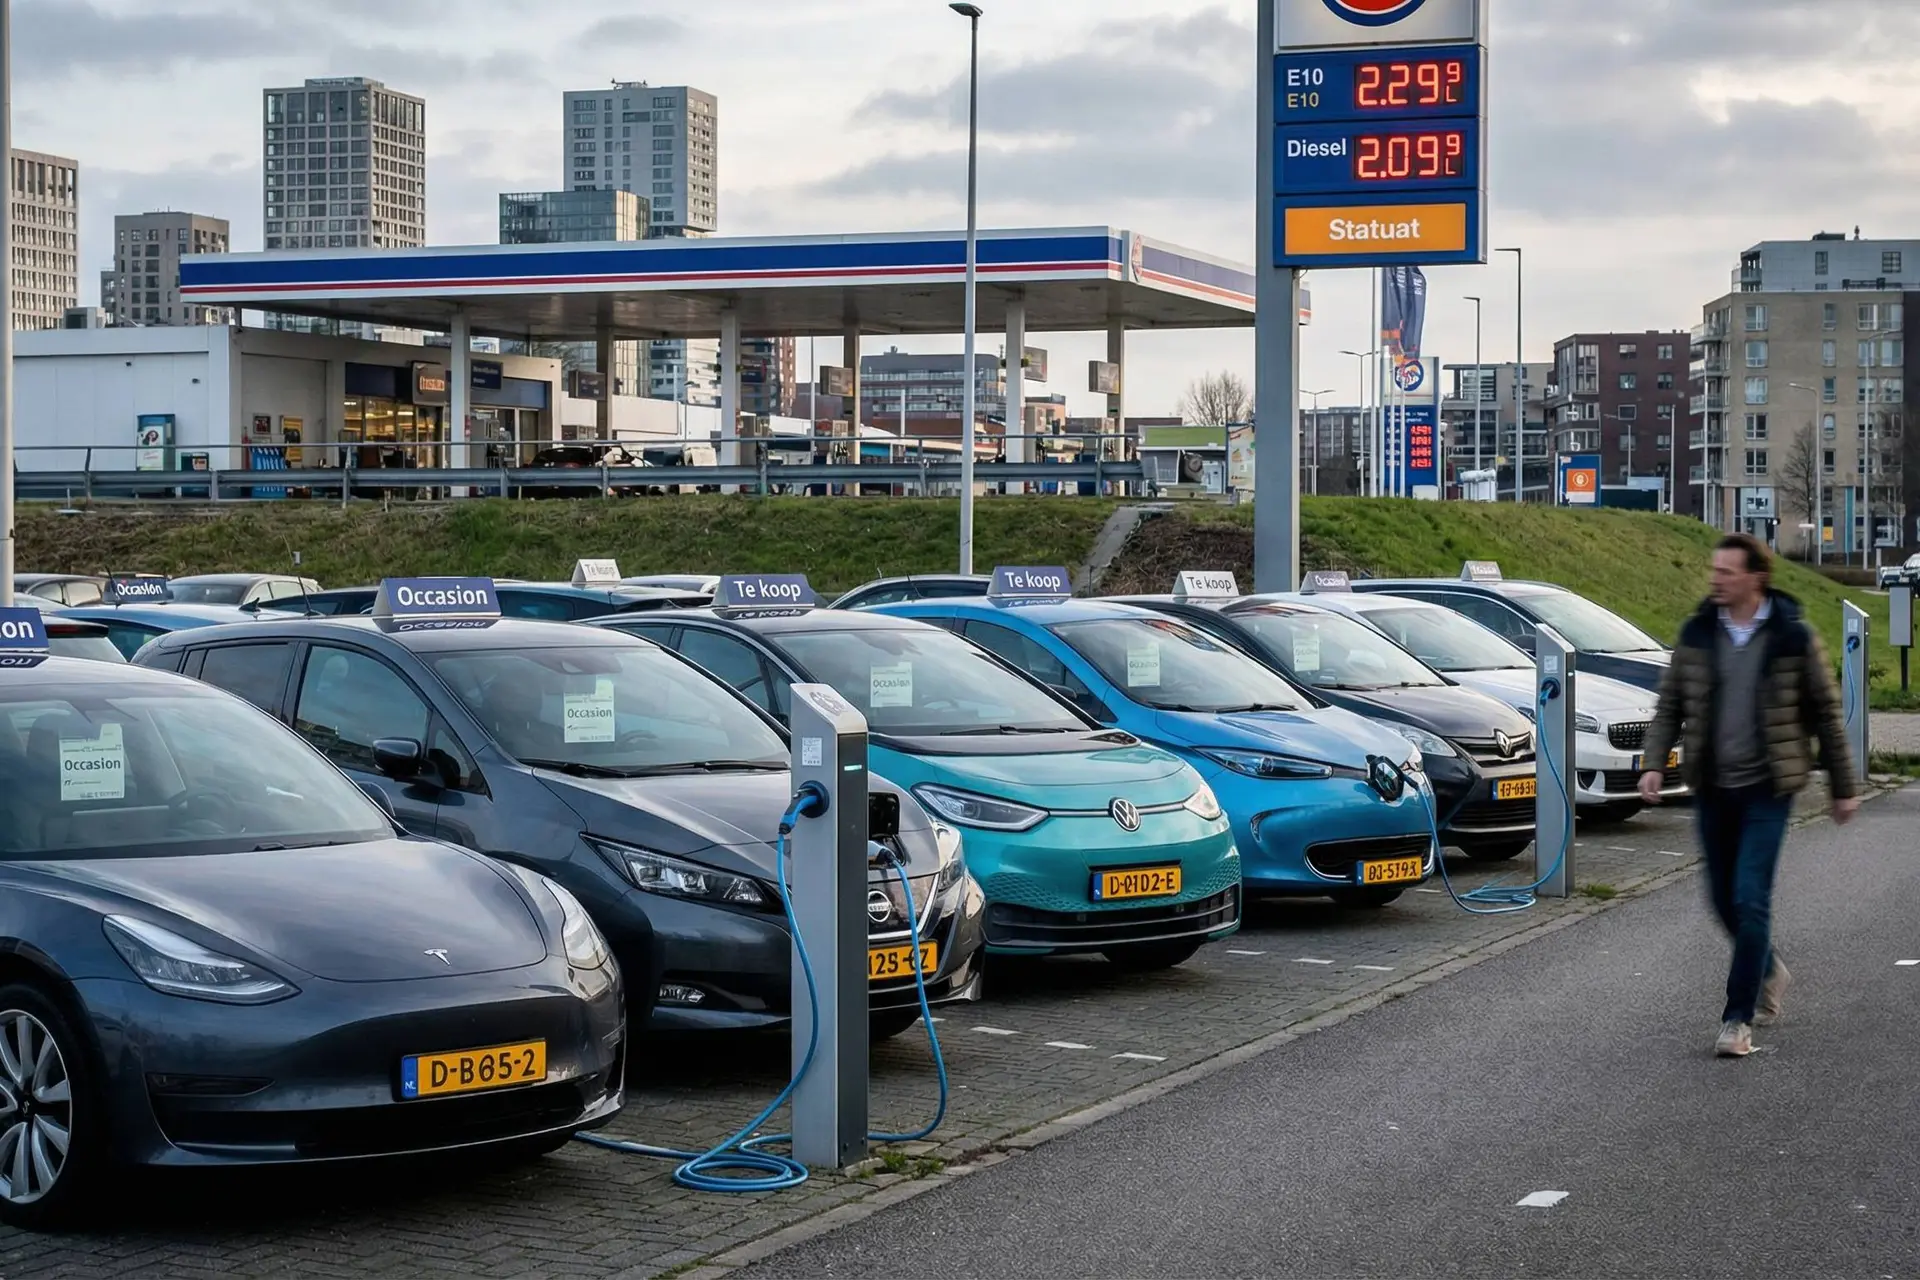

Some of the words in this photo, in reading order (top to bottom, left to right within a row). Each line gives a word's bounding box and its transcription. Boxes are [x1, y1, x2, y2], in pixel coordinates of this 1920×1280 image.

[1287, 68, 1324, 87] E10
[1287, 92, 1320, 108] E10
[1287, 138, 1347, 157] Diesel
[1328, 217, 1421, 241] Statuat
[733, 580, 756, 598] Te
[759, 578, 801, 602] koop
[1004, 572, 1023, 588] Te
[1025, 570, 1060, 592] koop
[1186, 576, 1202, 589] Te
[1204, 575, 1232, 593] koop
[397, 584, 488, 606] Occasion
[64, 757, 121, 771] Occasion
[431, 1049, 535, 1088] D-B65-2
